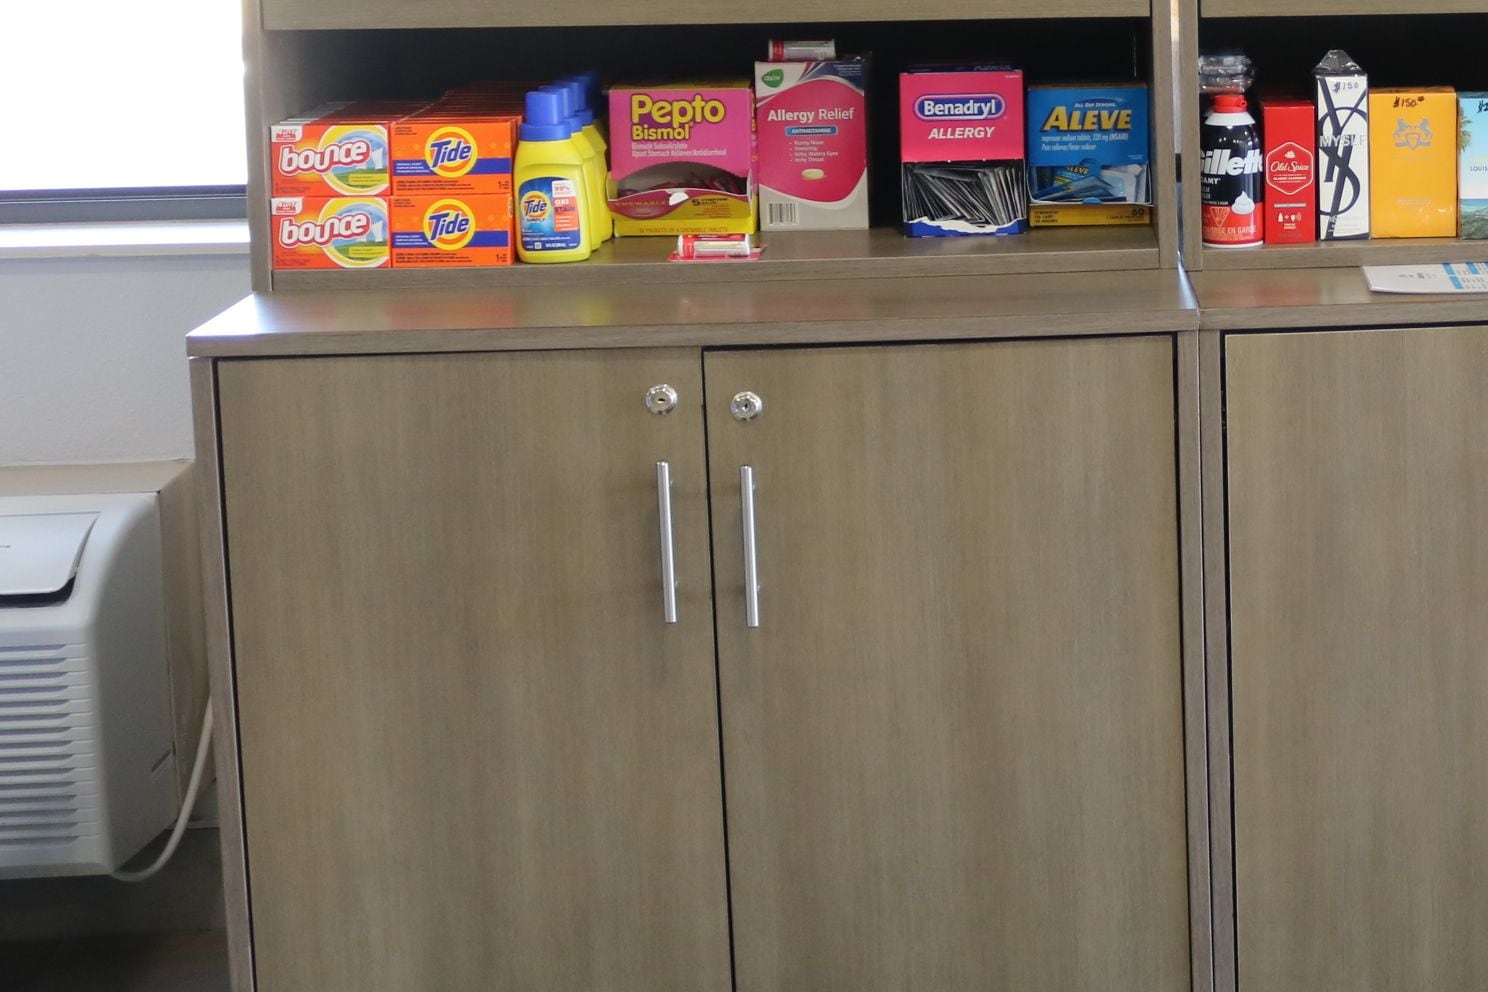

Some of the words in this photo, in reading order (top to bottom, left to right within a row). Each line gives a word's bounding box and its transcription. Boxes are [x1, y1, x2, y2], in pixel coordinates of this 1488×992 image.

[631, 95, 725, 128] Pepto
[768, 110, 815, 123] Allergy
[819, 108, 854, 120] Relief
[924, 100, 996, 119] Benadryl
[1042, 107, 1131, 131] ALEVE
[632, 125, 689, 140] Bismol
[928, 127, 995, 139] ALLERGY
[1320, 135, 1367, 147] MYSLF
[282, 141, 367, 172] bounce
[431, 140, 471, 168] Tide
[1271, 162, 1287, 171] Old
[1288, 160, 1309, 171] Spice
[524, 199, 547, 216] Tide
[282, 214, 368, 245] bounce
[429, 212, 469, 241] Tide
